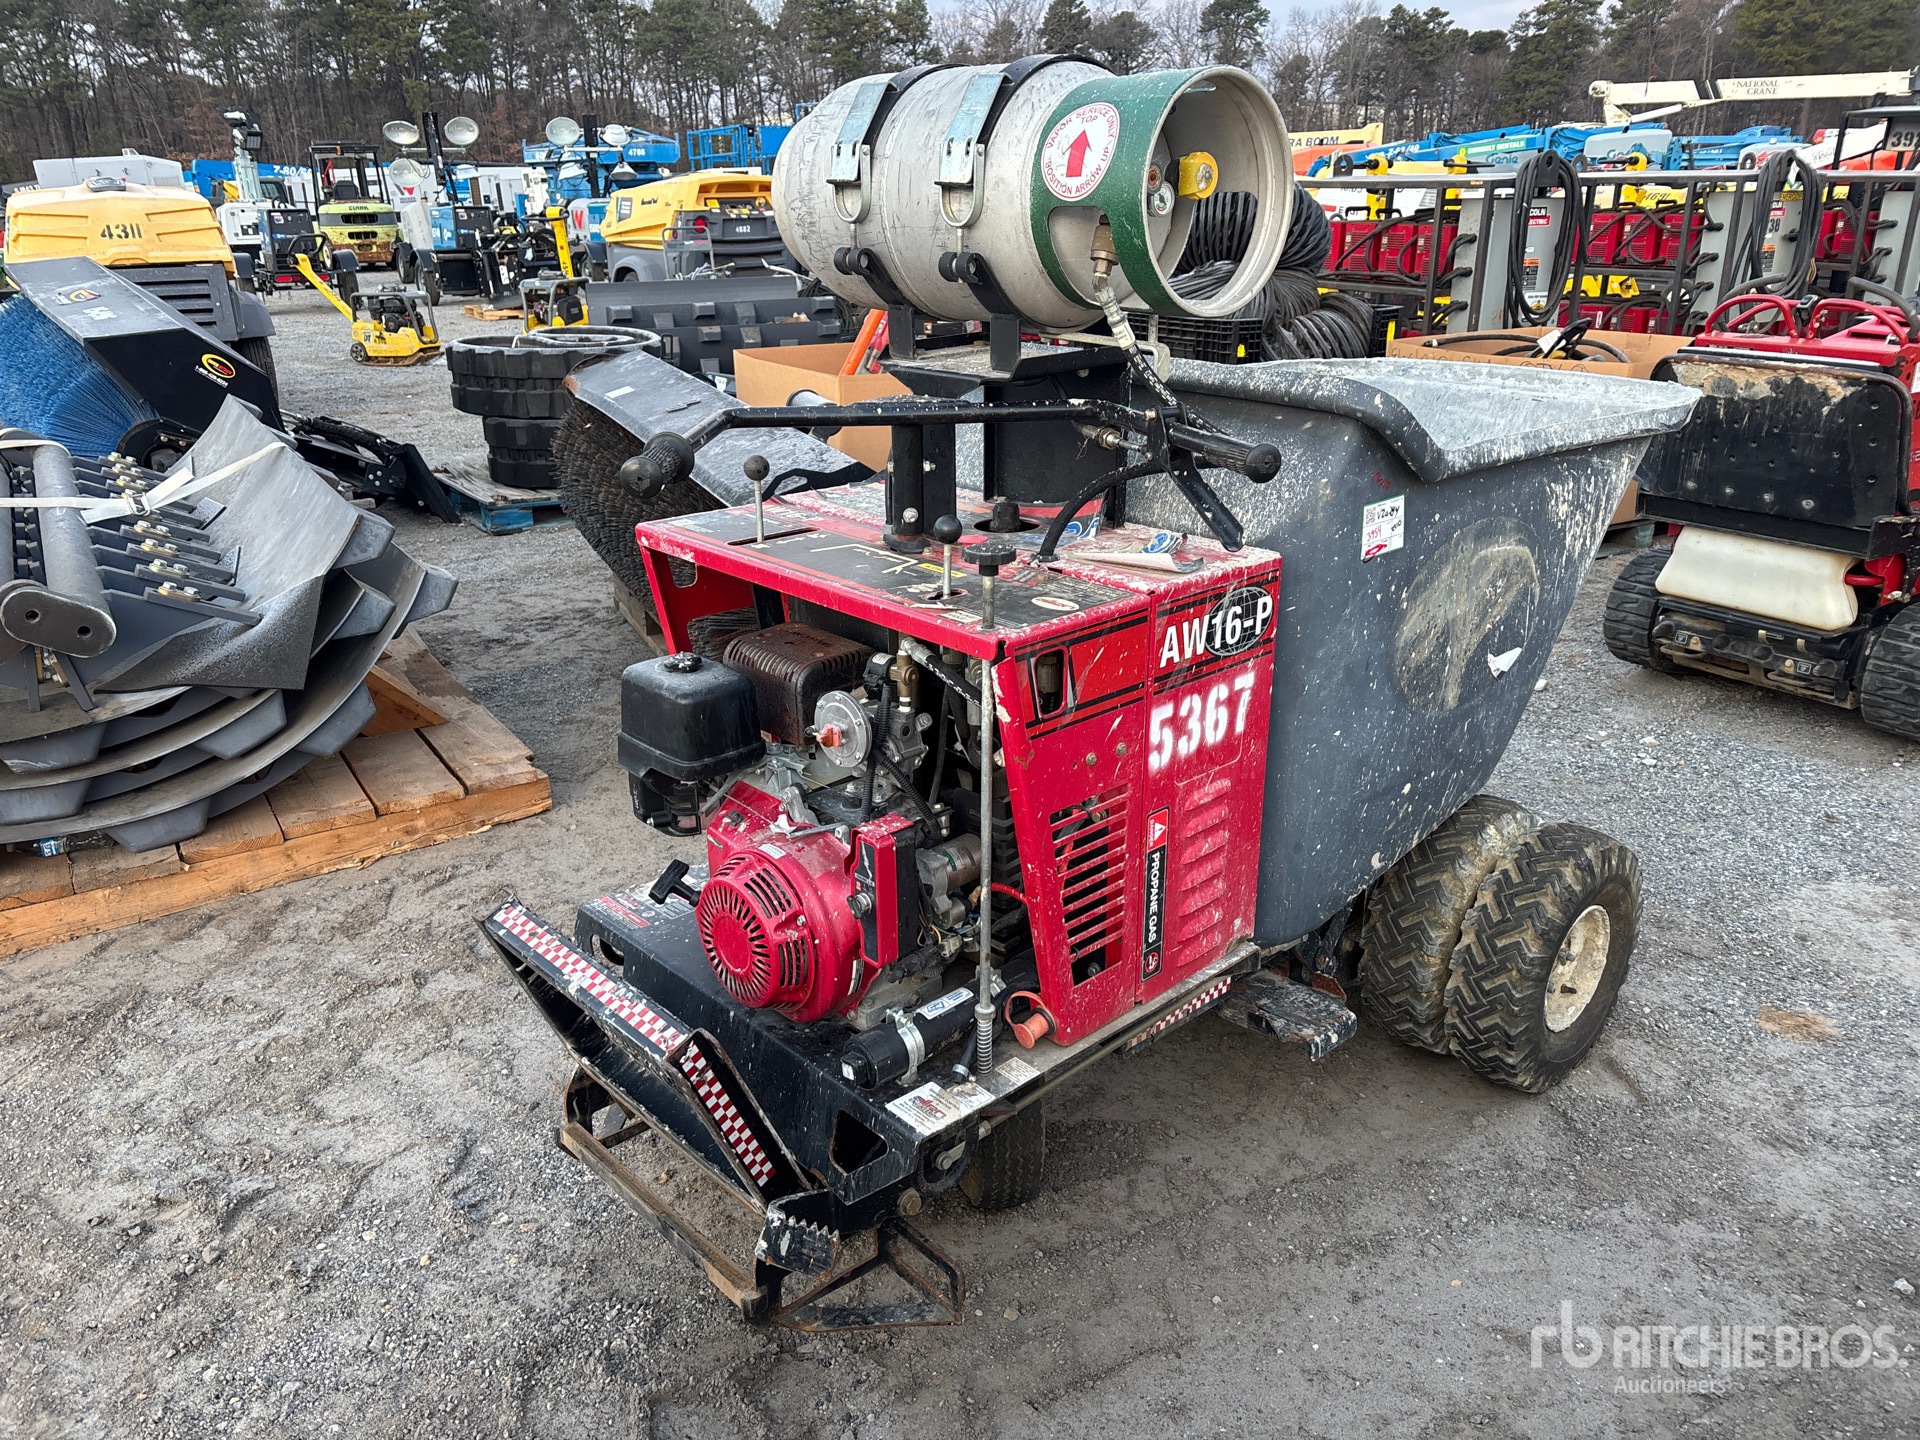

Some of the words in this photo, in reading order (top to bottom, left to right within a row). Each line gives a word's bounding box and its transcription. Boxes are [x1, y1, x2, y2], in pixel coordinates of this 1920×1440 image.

[1736, 80, 1779, 88] NATIONAL
[1747, 87, 1778, 95] CRANE
[1046, 117, 1073, 149] VAPOR
[1076, 107, 1110, 118] SERVICE
[1106, 115, 1116, 138] ONLY
[1081, 115, 1098, 124] TOP
[1305, 136, 1339, 146] BOOM
[1074, 163, 1103, 195] ARROW
[1100, 146, 1110, 162] UP
[1486, 154, 1519, 165] Genie
[100, 223, 142, 240] 4311
[1159, 594, 1273, 669] AW16-P
[1148, 672, 1255, 770] 5367
[1149, 851, 1160, 915] PROPANE
[1148, 915, 1158, 943] GAS
